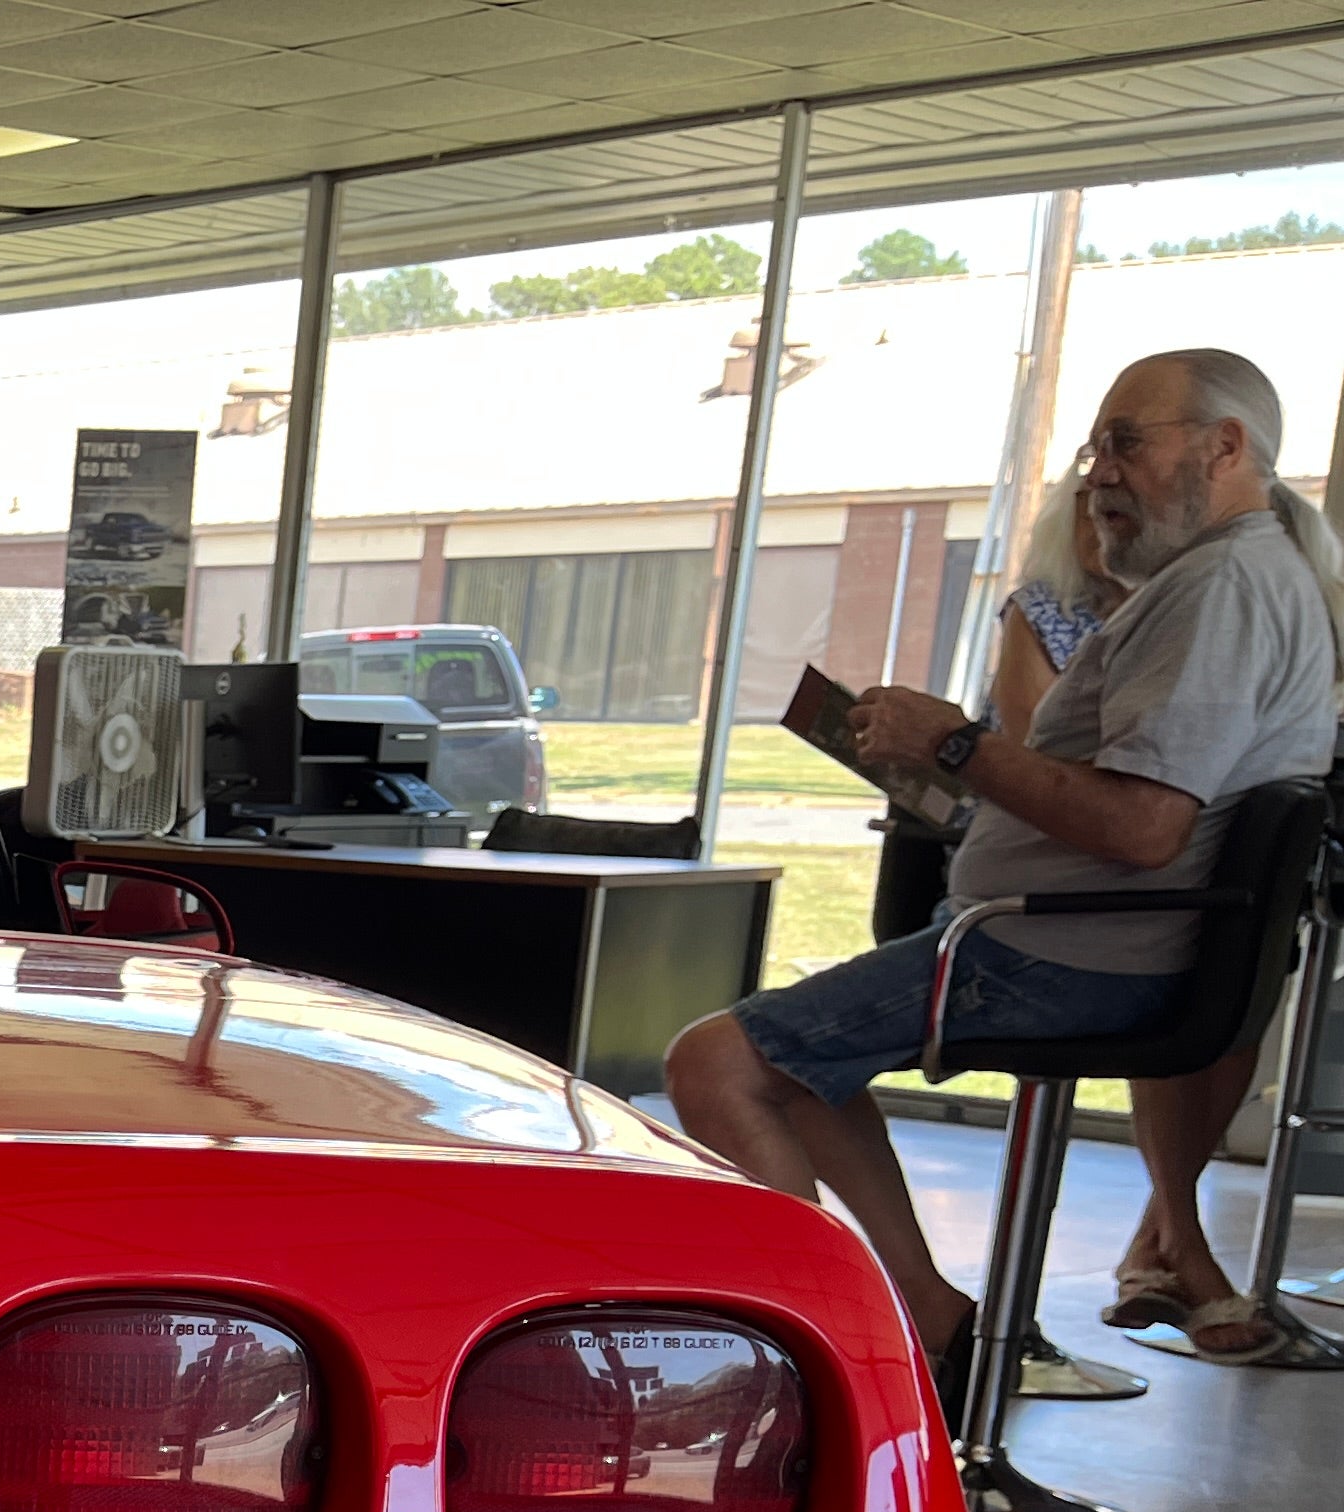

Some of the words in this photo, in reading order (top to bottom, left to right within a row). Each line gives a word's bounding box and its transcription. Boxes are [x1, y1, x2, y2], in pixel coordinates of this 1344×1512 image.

[81, 442, 118, 458] TIME
[120, 443, 141, 458] TO
[78, 462, 100, 477] GO
